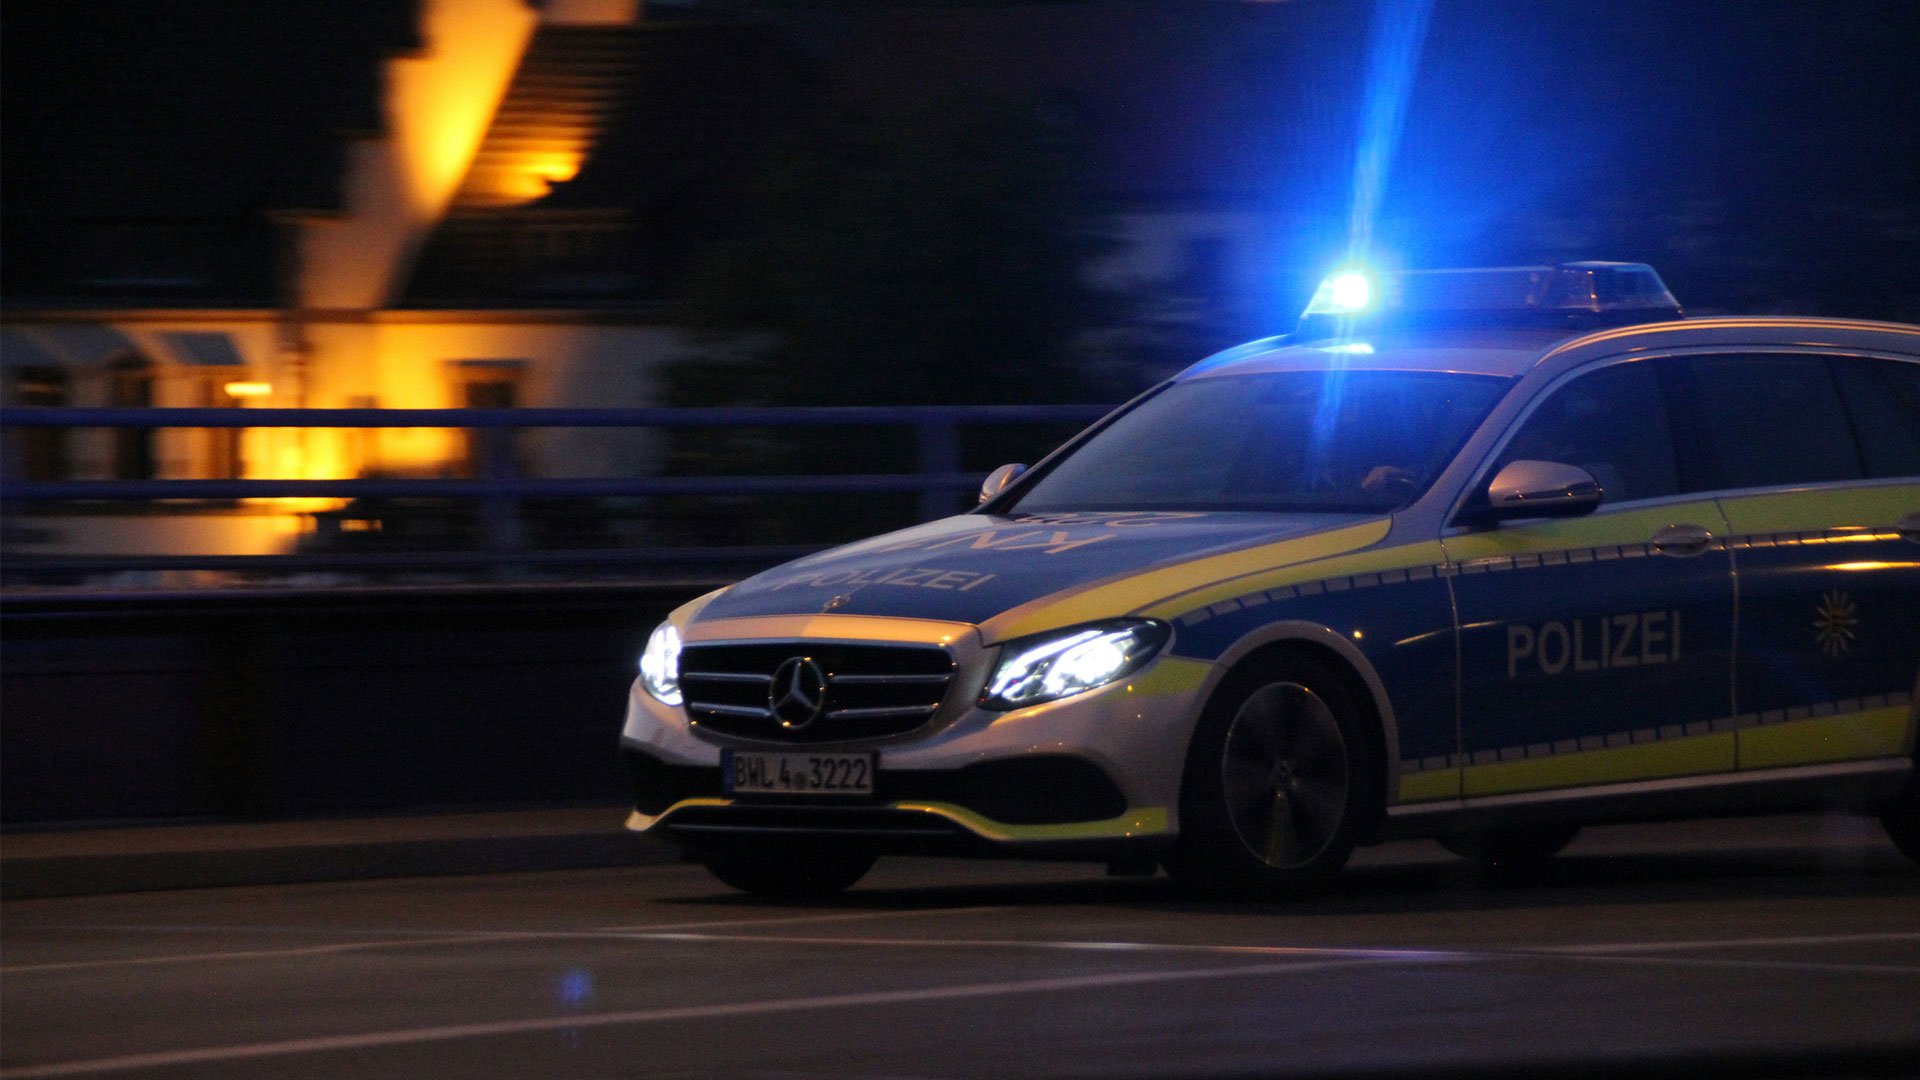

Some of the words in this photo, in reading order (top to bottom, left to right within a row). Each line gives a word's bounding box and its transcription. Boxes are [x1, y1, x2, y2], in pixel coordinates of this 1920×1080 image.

[770, 567, 997, 591] POLIZEI
[1507, 610, 1682, 680] POLIZEI
[809, 758, 869, 788] 3222
